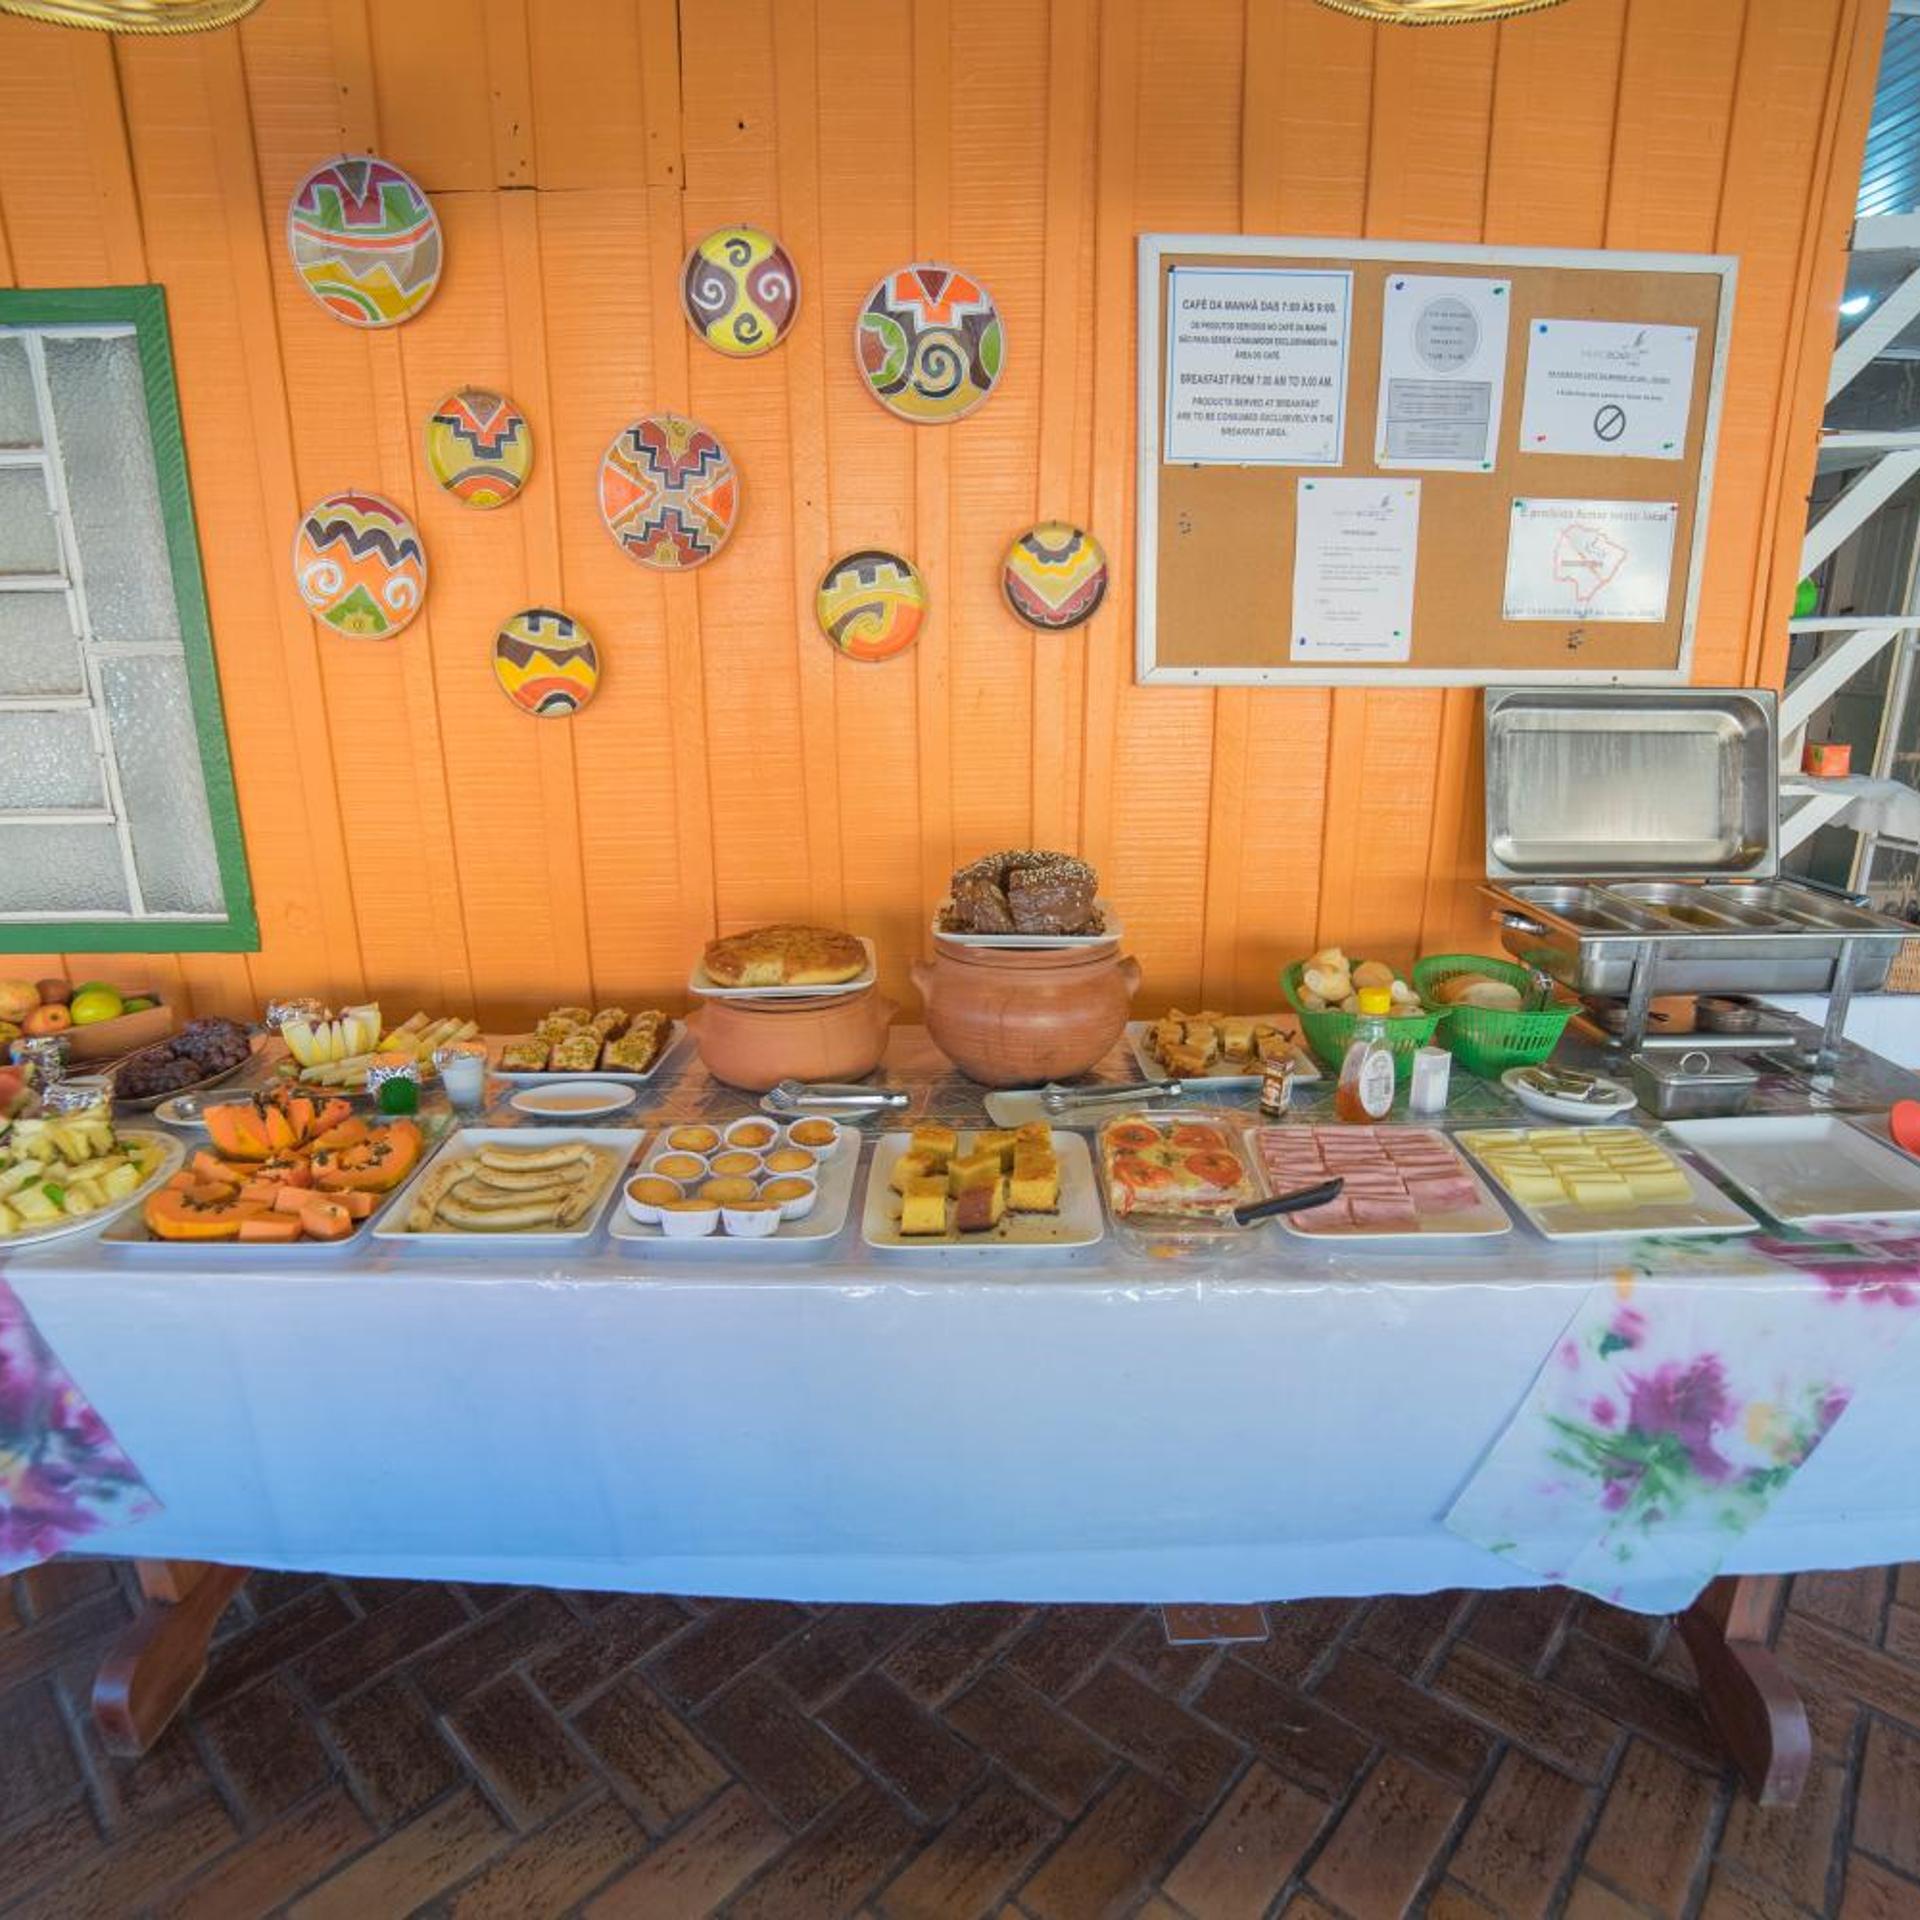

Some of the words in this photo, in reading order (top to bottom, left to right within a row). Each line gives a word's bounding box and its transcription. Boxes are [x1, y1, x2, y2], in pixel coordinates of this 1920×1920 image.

[1182, 296, 1207, 310] CAFÉ
[1209, 299, 1222, 310] DA
[1225, 299, 1258, 311] MANHÃ
[1260, 300, 1279, 312] DAS
[1201, 321, 1234, 331] PRODUTOS
[1180, 373, 1229, 385] BREAKFAST
[1230, 374, 1254, 386] FROM
[1274, 376, 1287, 386] AM
[1288, 376, 1299, 387] TO
[1192, 397, 1232, 406] PRODUCTS
[1234, 398, 1263, 407] SERVED
[1265, 399, 1274, 408] AT
[1276, 399, 1320, 408] BREAKFAST
[1216, 412, 1258, 422] CONSUMED
[1221, 427, 1264, 437] BREAKFAST
